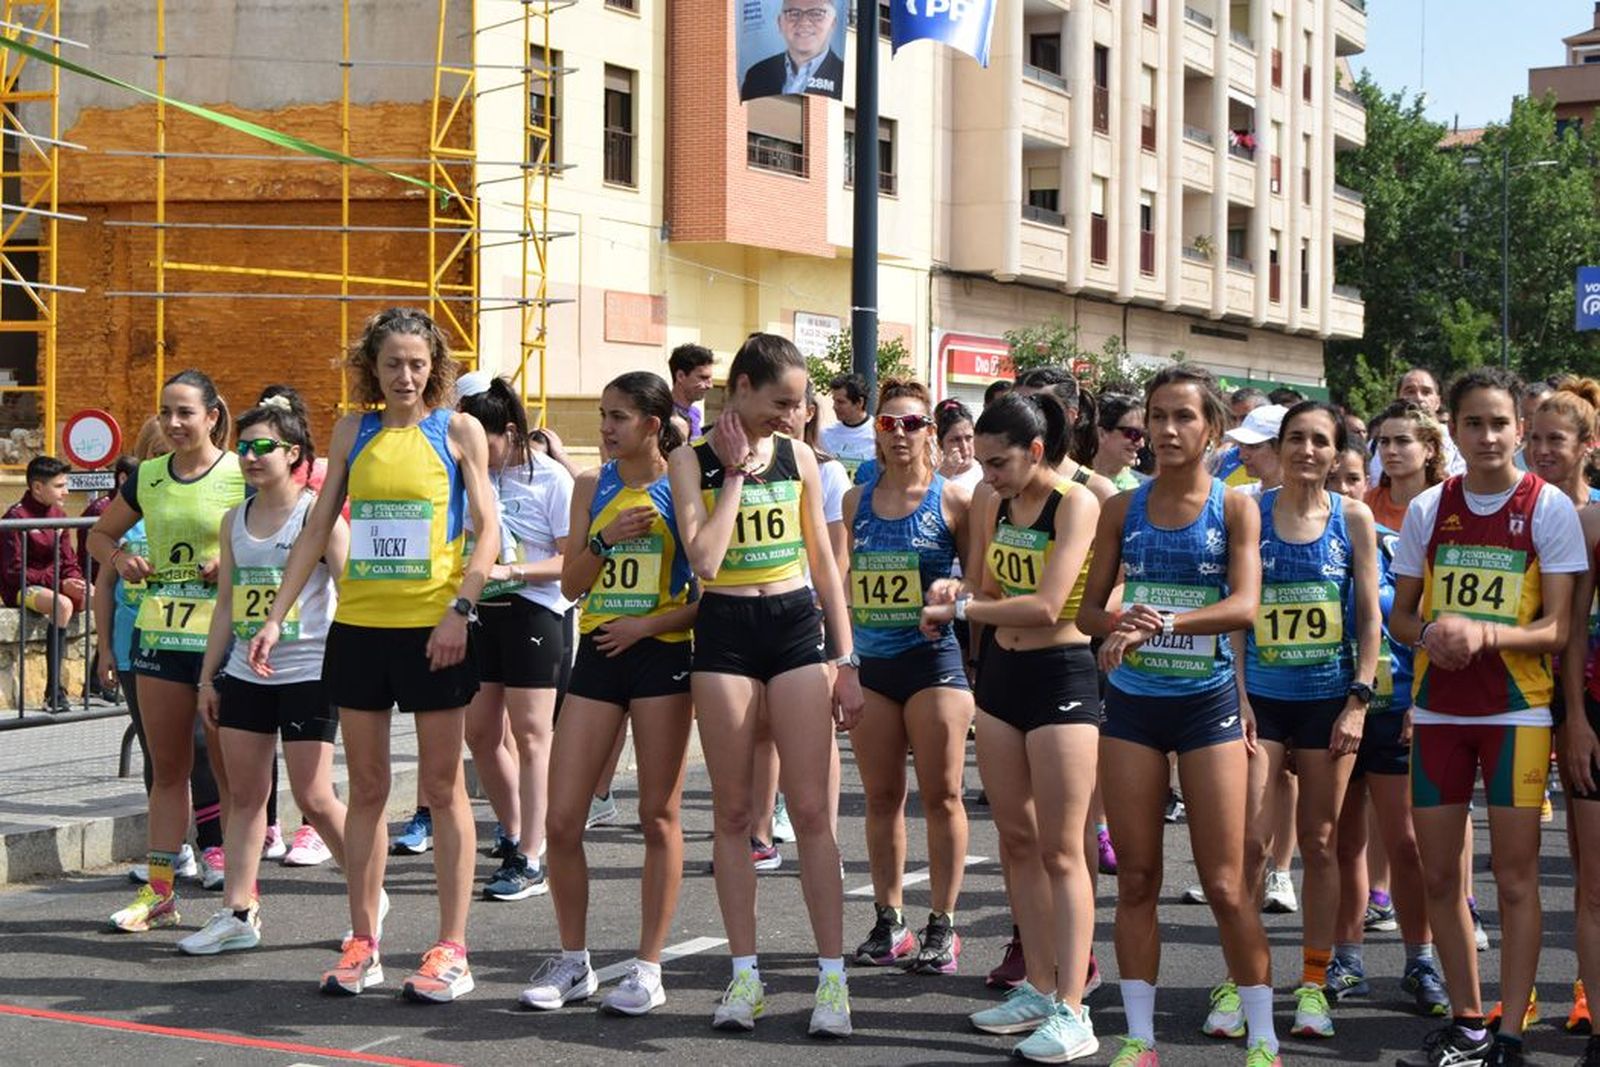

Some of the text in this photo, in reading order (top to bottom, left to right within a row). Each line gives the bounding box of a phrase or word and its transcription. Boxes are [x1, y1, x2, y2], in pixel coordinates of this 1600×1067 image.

[807, 77, 834, 92] 28M
[735, 508, 785, 544] 116
[372, 538, 407, 558] VICKI
[1461, 550, 1514, 562] FUNDACION
[373, 564, 427, 575] CAJA RURAL
[602, 557, 639, 589] 30
[993, 548, 1036, 586] 201
[857, 575, 910, 604] 142
[1151, 587, 1207, 600] FUNDACION
[1278, 585, 1328, 597] FUNDACION
[1441, 571, 1505, 610] 184
[245, 589, 277, 617] 23
[603, 598, 623, 608] CAJA
[1150, 596, 1206, 607] CAJA RURAL
[162, 600, 196, 628] 17
[1264, 607, 1327, 641] 179
[160, 636, 180, 645] CAJA
[1279, 650, 1303, 659] CAJA
[1143, 657, 1208, 671] CAJA RURAL
